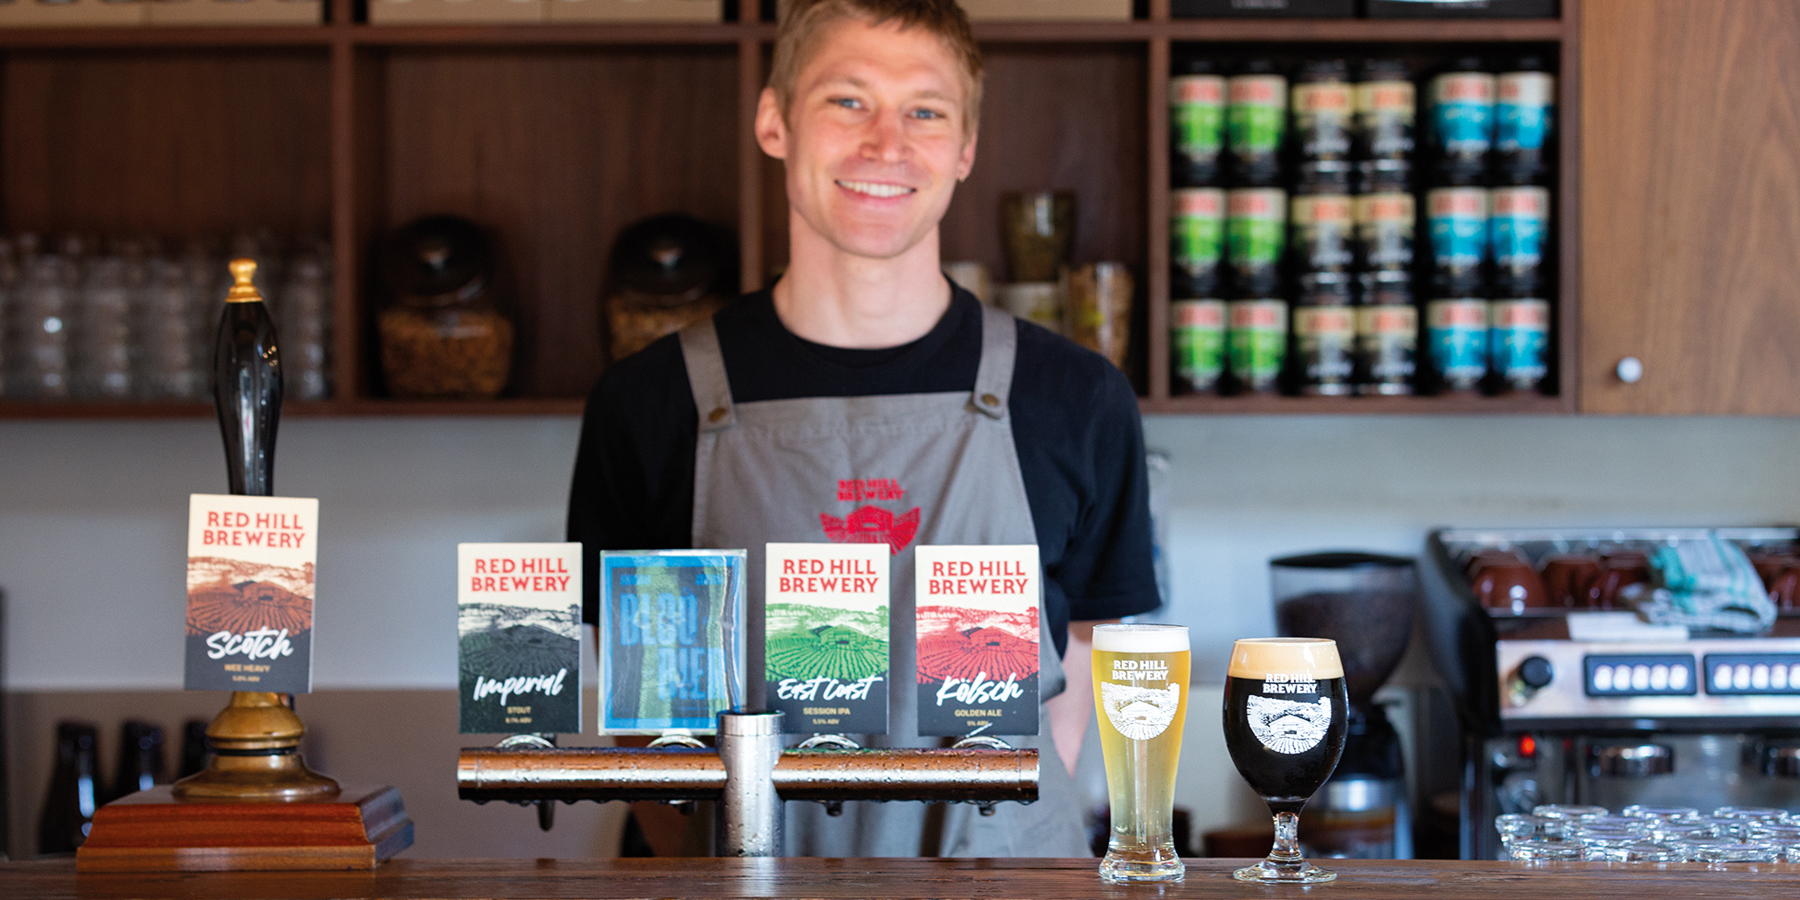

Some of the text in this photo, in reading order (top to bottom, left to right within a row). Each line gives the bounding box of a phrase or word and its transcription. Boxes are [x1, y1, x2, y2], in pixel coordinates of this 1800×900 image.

[838, 478, 901, 489] RED HILL
[837, 490, 905, 501] BREWERY
[207, 511, 303, 530] RED HILL
[202, 530, 305, 548] BREWERY
[475, 558, 568, 573] RED HILL
[783, 559, 876, 575] RED HILL
[932, 560, 1026, 577] RED HILL
[471, 576, 570, 592] BREWERY
[779, 577, 879, 593] BREWERY
[929, 578, 1029, 595] BREWERY
[206, 626, 294, 660] Scotch
[224, 663, 271, 673] WEE HEAVY
[1113, 660, 1168, 670] RED HILL
[1111, 670, 1169, 681] BREWERY
[1265, 673, 1316, 683] RED HILL
[473, 668, 567, 707] Imperial
[777, 674, 883, 701] East Coast
[936, 670, 1024, 707] Kölsch
[1262, 683, 1318, 694] BREWERY
[507, 706, 532, 714] STOUT
[803, 707, 851, 715] SESSION IPA
[954, 709, 1002, 717] GOLDEN ALE
